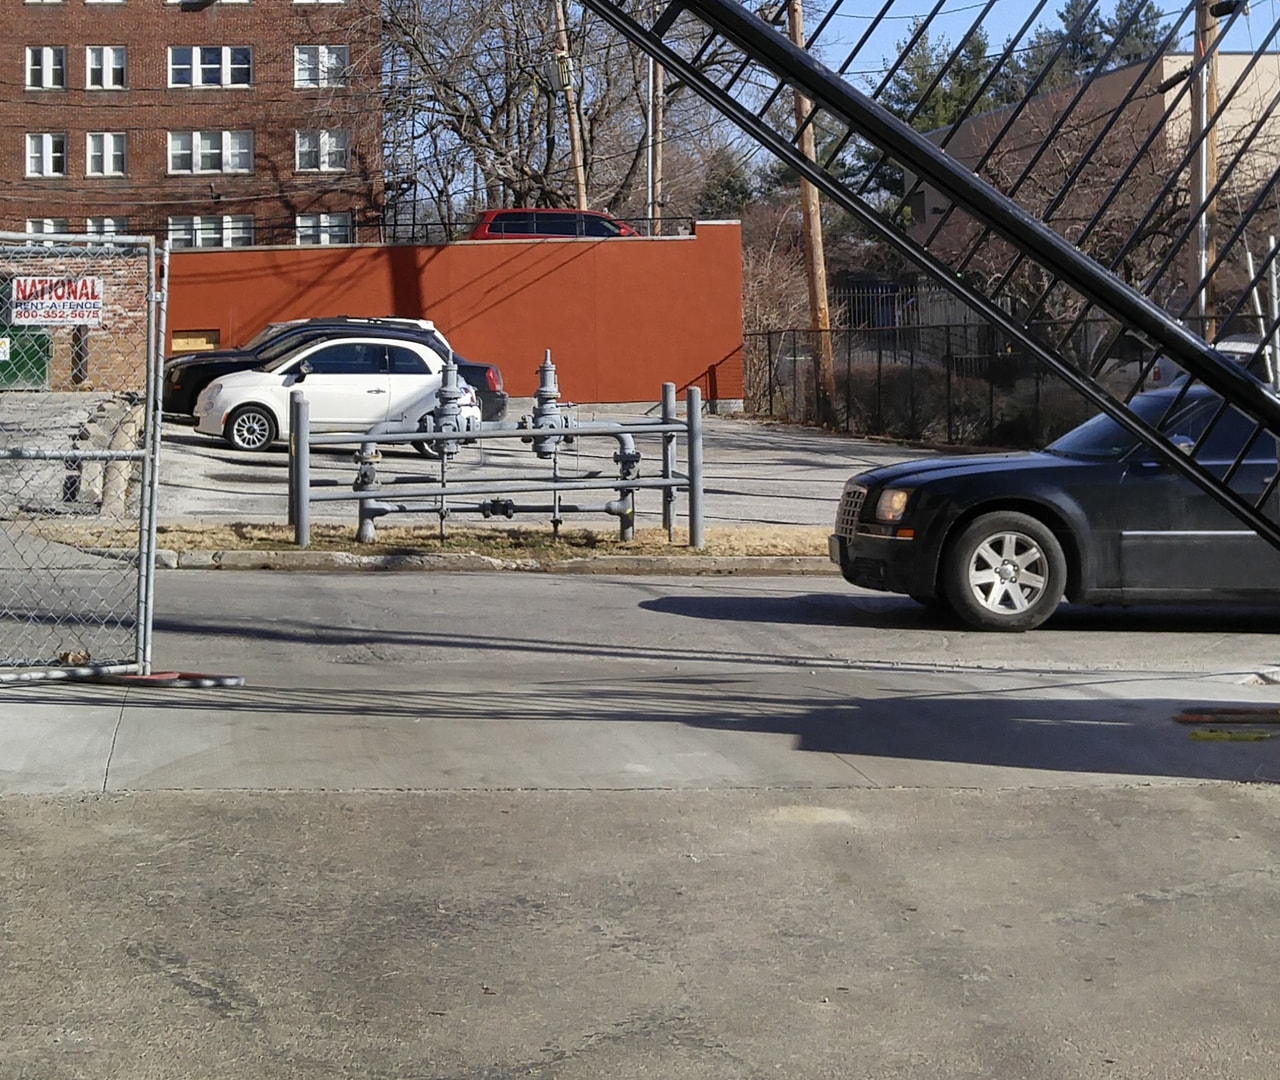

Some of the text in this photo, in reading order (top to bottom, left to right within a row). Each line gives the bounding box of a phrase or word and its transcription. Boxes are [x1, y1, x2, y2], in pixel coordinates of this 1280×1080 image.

[16, 279, 100, 301] NATIONAL
[15, 301, 100, 310] RENT-A-FENCE
[15, 310, 99, 319] 800-352-5675
